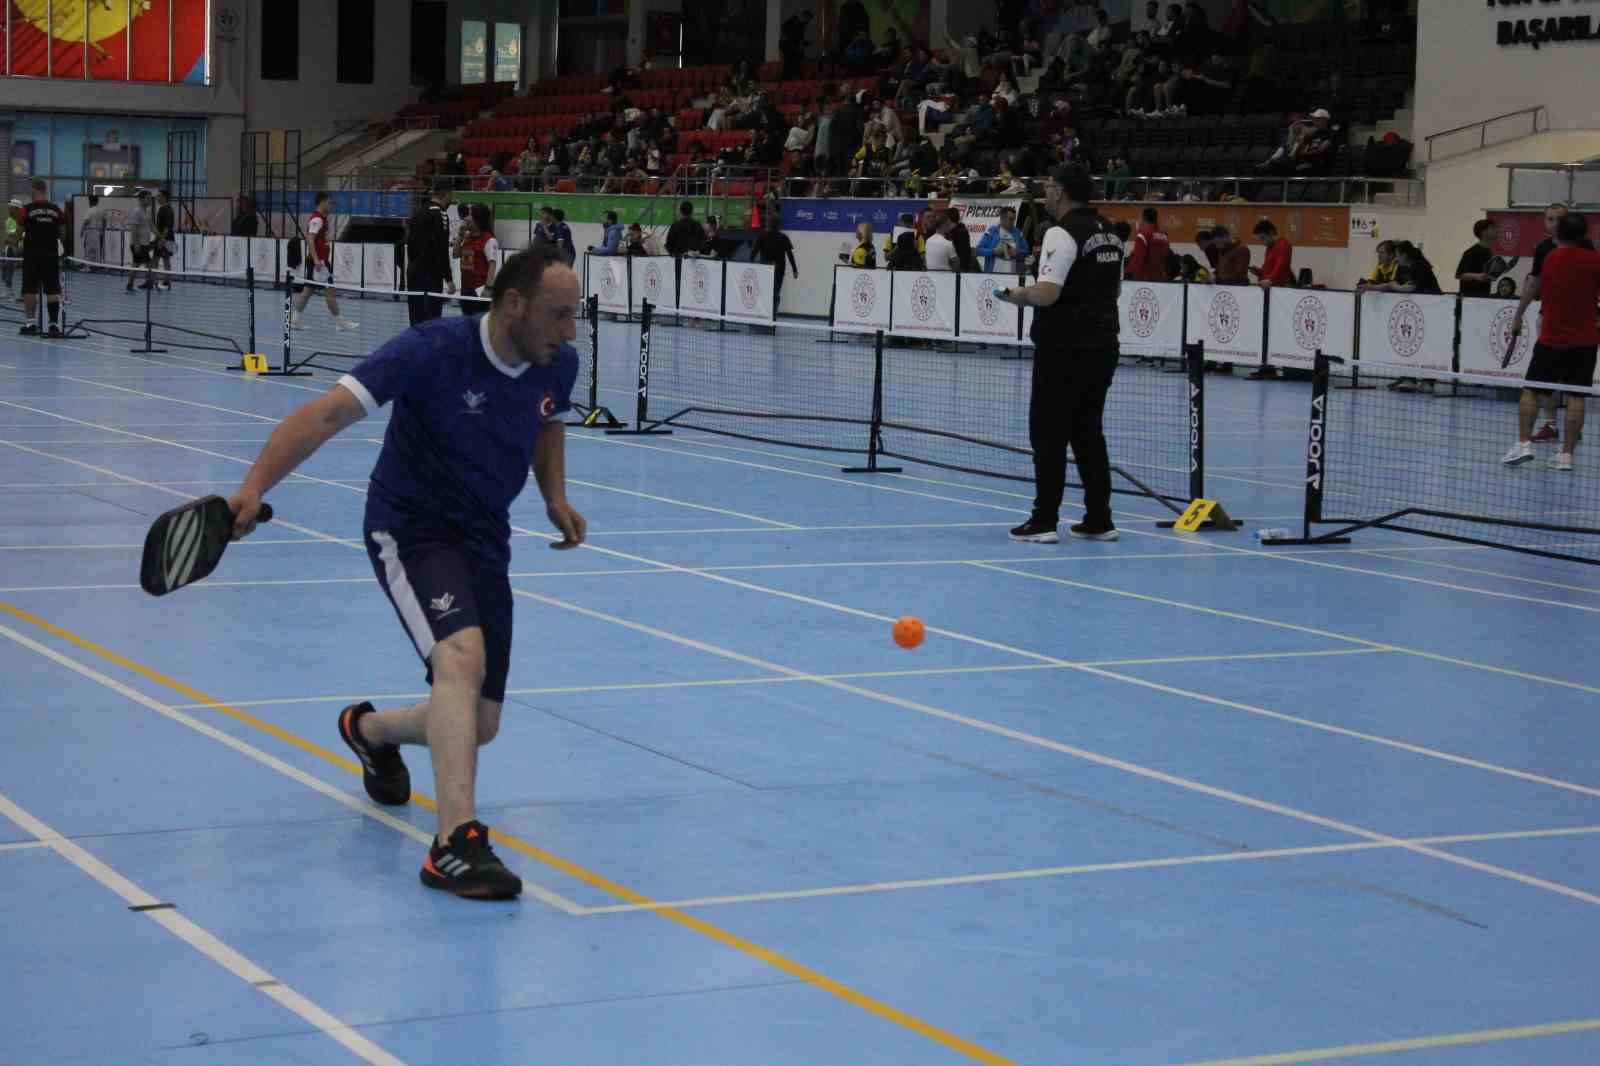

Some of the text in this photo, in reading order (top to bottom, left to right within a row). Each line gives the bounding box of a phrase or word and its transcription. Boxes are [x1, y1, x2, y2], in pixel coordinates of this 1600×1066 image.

[1496, 15, 1600, 50] BAŞARIL
[250, 356, 260, 370] 7
[640, 331, 649, 384] JOOLA
[1308, 393, 1325, 471] JOOLA
